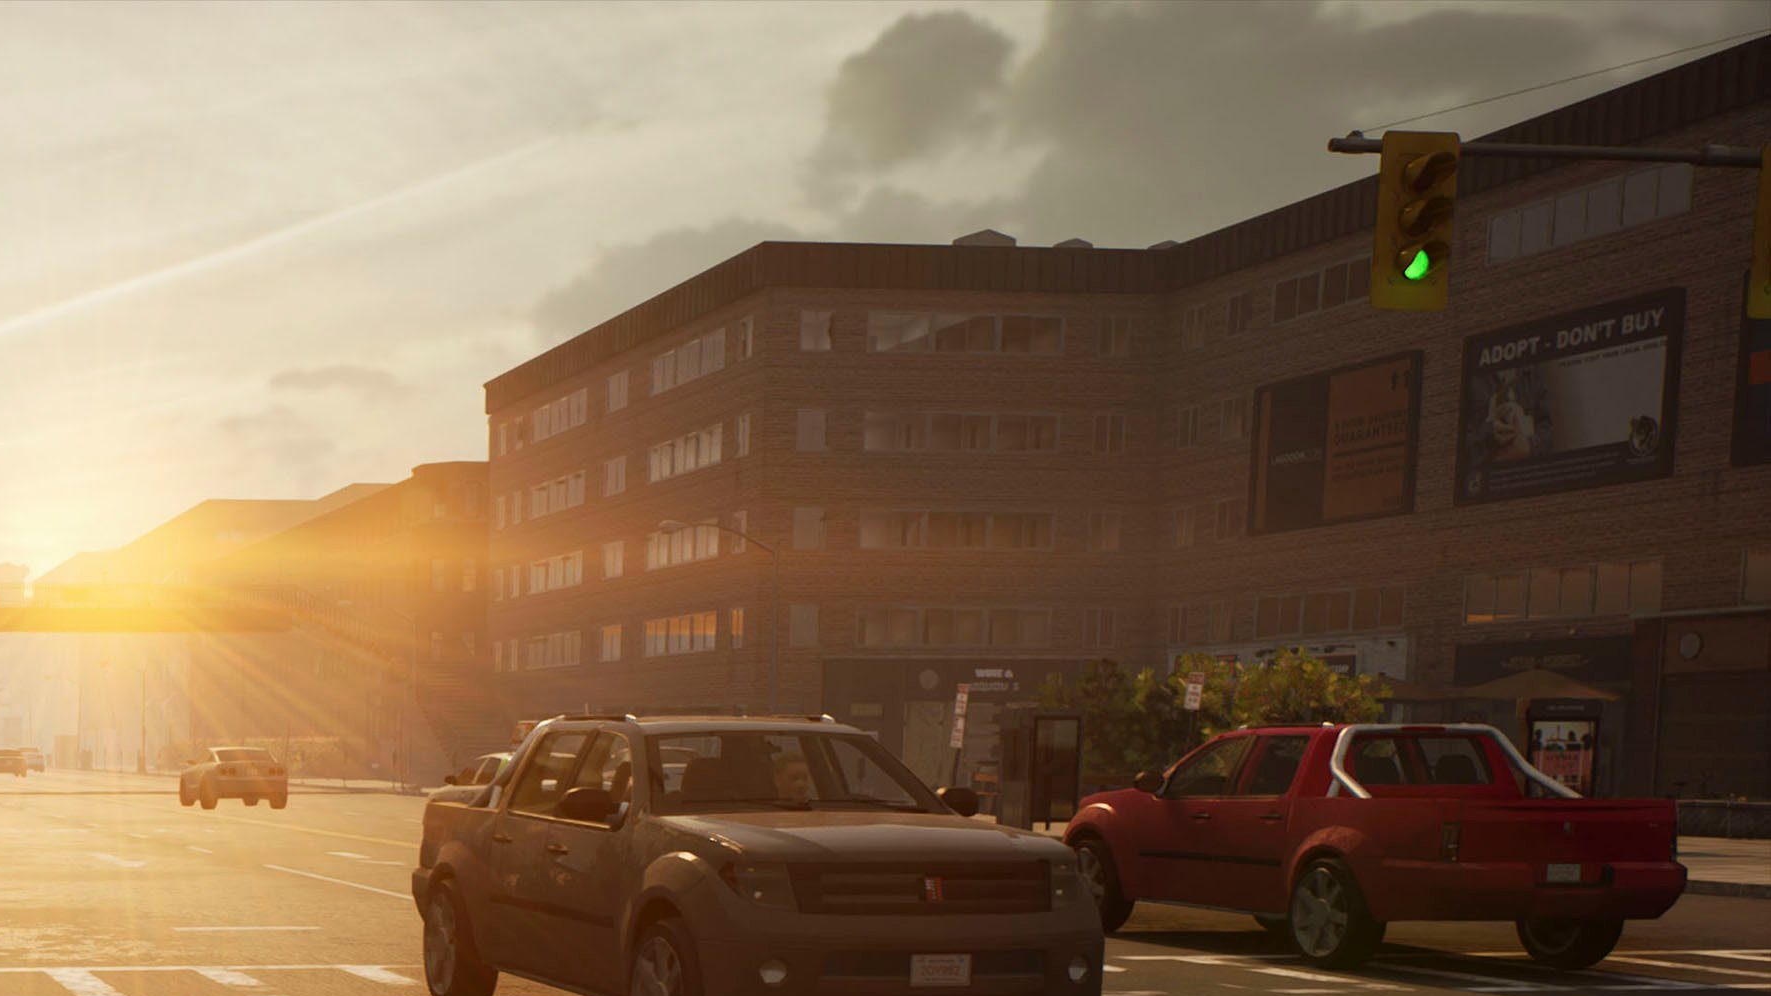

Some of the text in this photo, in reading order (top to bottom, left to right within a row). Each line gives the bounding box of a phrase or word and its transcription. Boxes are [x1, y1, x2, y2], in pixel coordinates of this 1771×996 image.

[1478, 336, 1540, 368] ADOPT
[1556, 319, 1616, 350] DON'T
[1621, 307, 1665, 335] BUY
